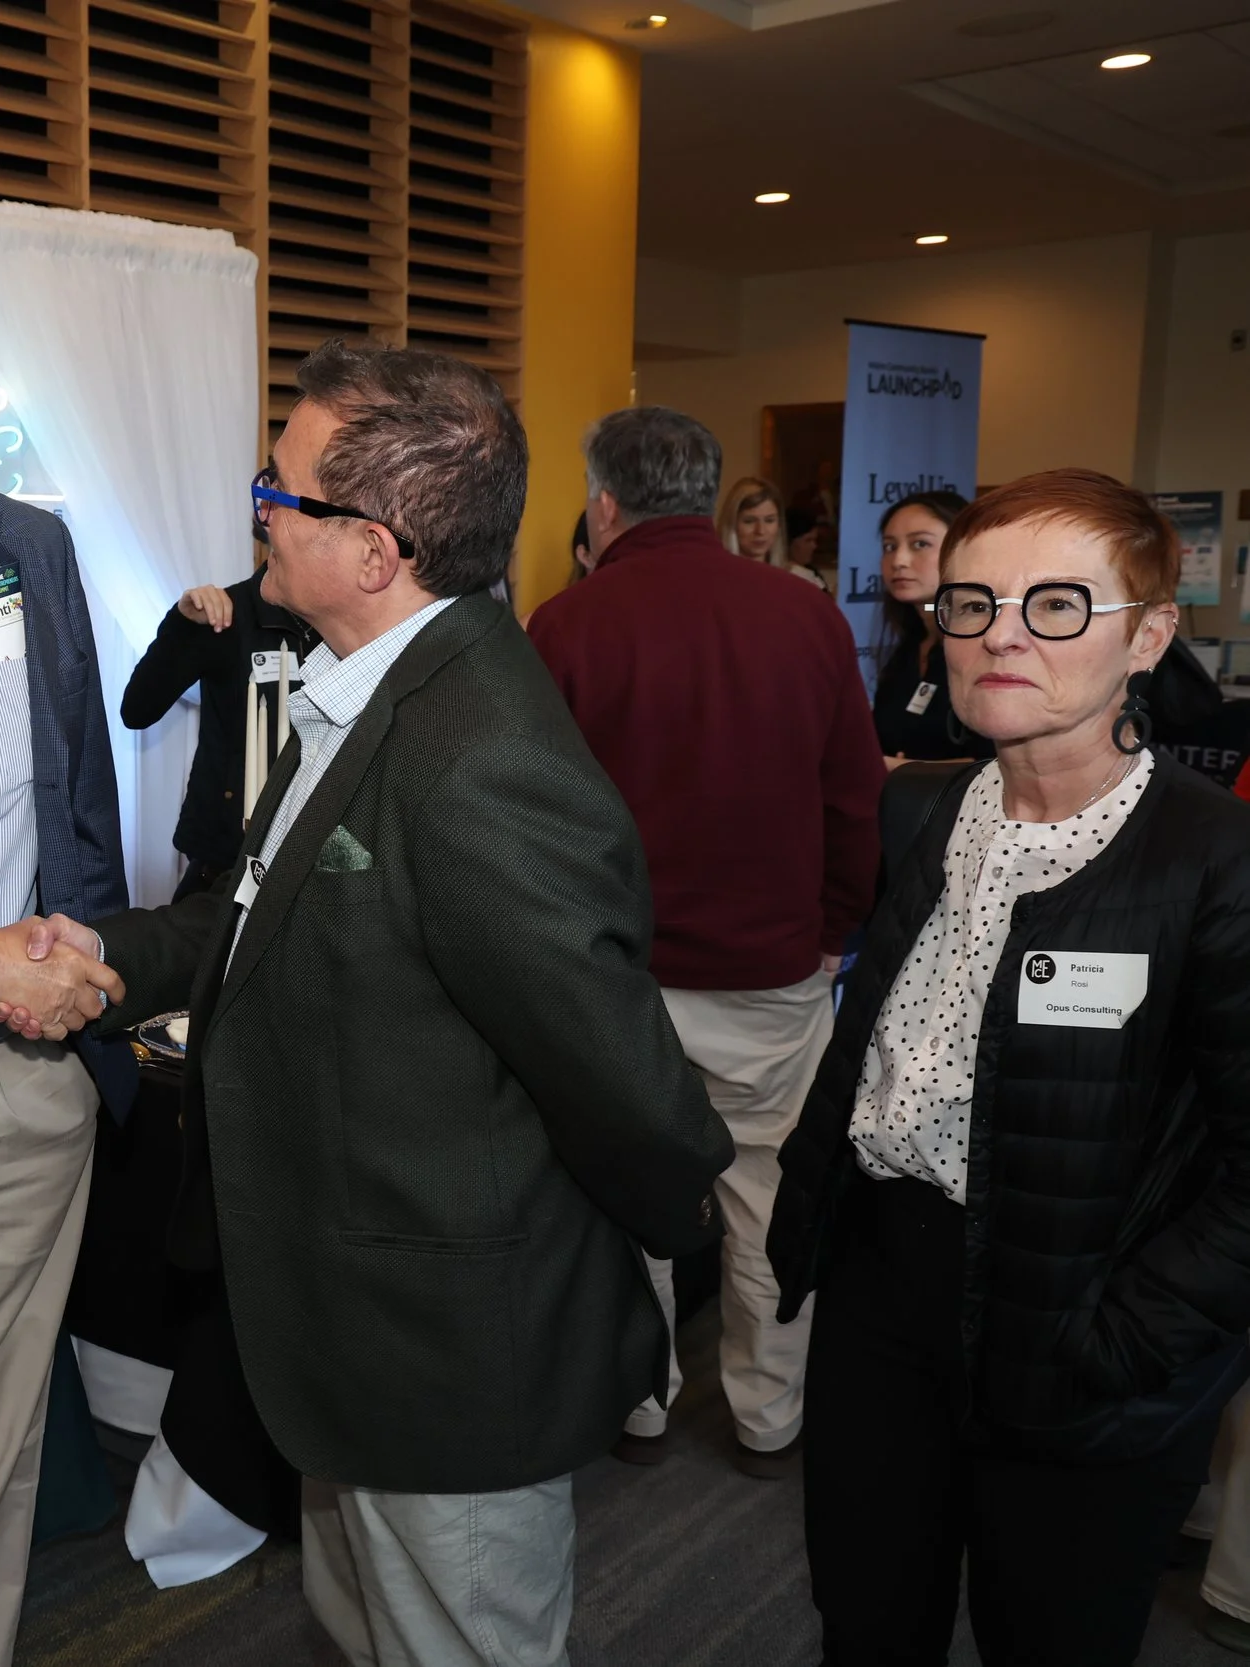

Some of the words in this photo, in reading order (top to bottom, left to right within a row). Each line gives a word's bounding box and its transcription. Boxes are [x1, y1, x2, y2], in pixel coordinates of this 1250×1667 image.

[1070, 964, 1104, 973] Patricia
[1046, 1004, 1070, 1013] Opus
[1072, 1005, 1122, 1016] Consulting
